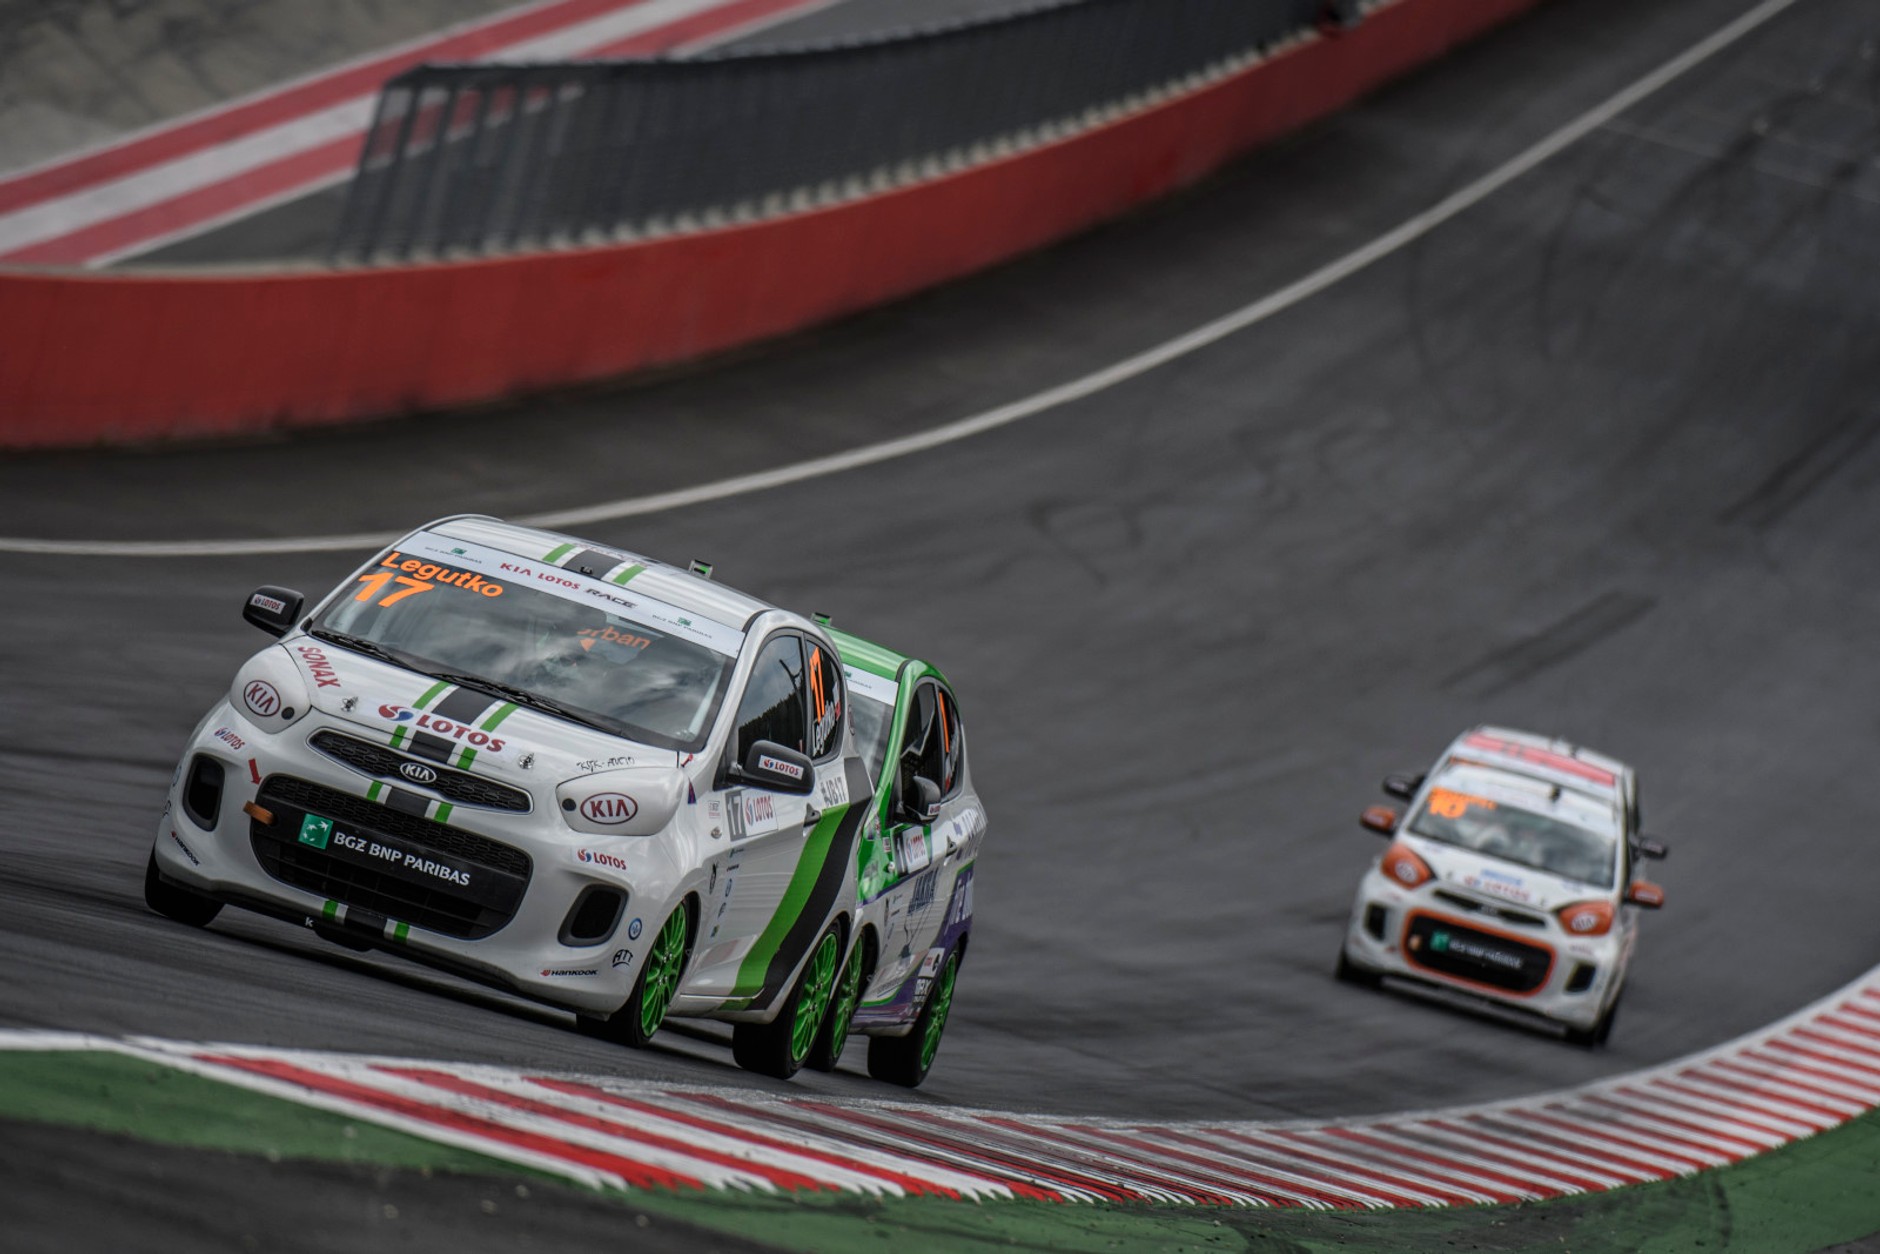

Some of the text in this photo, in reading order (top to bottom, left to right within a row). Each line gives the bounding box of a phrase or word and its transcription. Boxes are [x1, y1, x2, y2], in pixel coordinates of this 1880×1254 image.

[354, 571, 435, 608] 17
[380, 552, 503, 597] Legutko
[500, 562, 637, 609] KIA LOTOS RACE
[261, 598, 281, 610] LOTOS
[297, 646, 341, 688] SONAX
[247, 683, 275, 714] KIA
[220, 731, 246, 750] LOTOS
[416, 714, 506, 752] LOTOS
[405, 765, 430, 781] KIA
[774, 762, 800, 776] LOTOS
[590, 799, 630, 817] KIA
[728, 796, 743, 836] 17
[752, 796, 774, 822] LOTOS
[368, 843, 402, 862] BNP
[403, 854, 470, 886] PARIBAS
[593, 851, 627, 870] LOTOS
